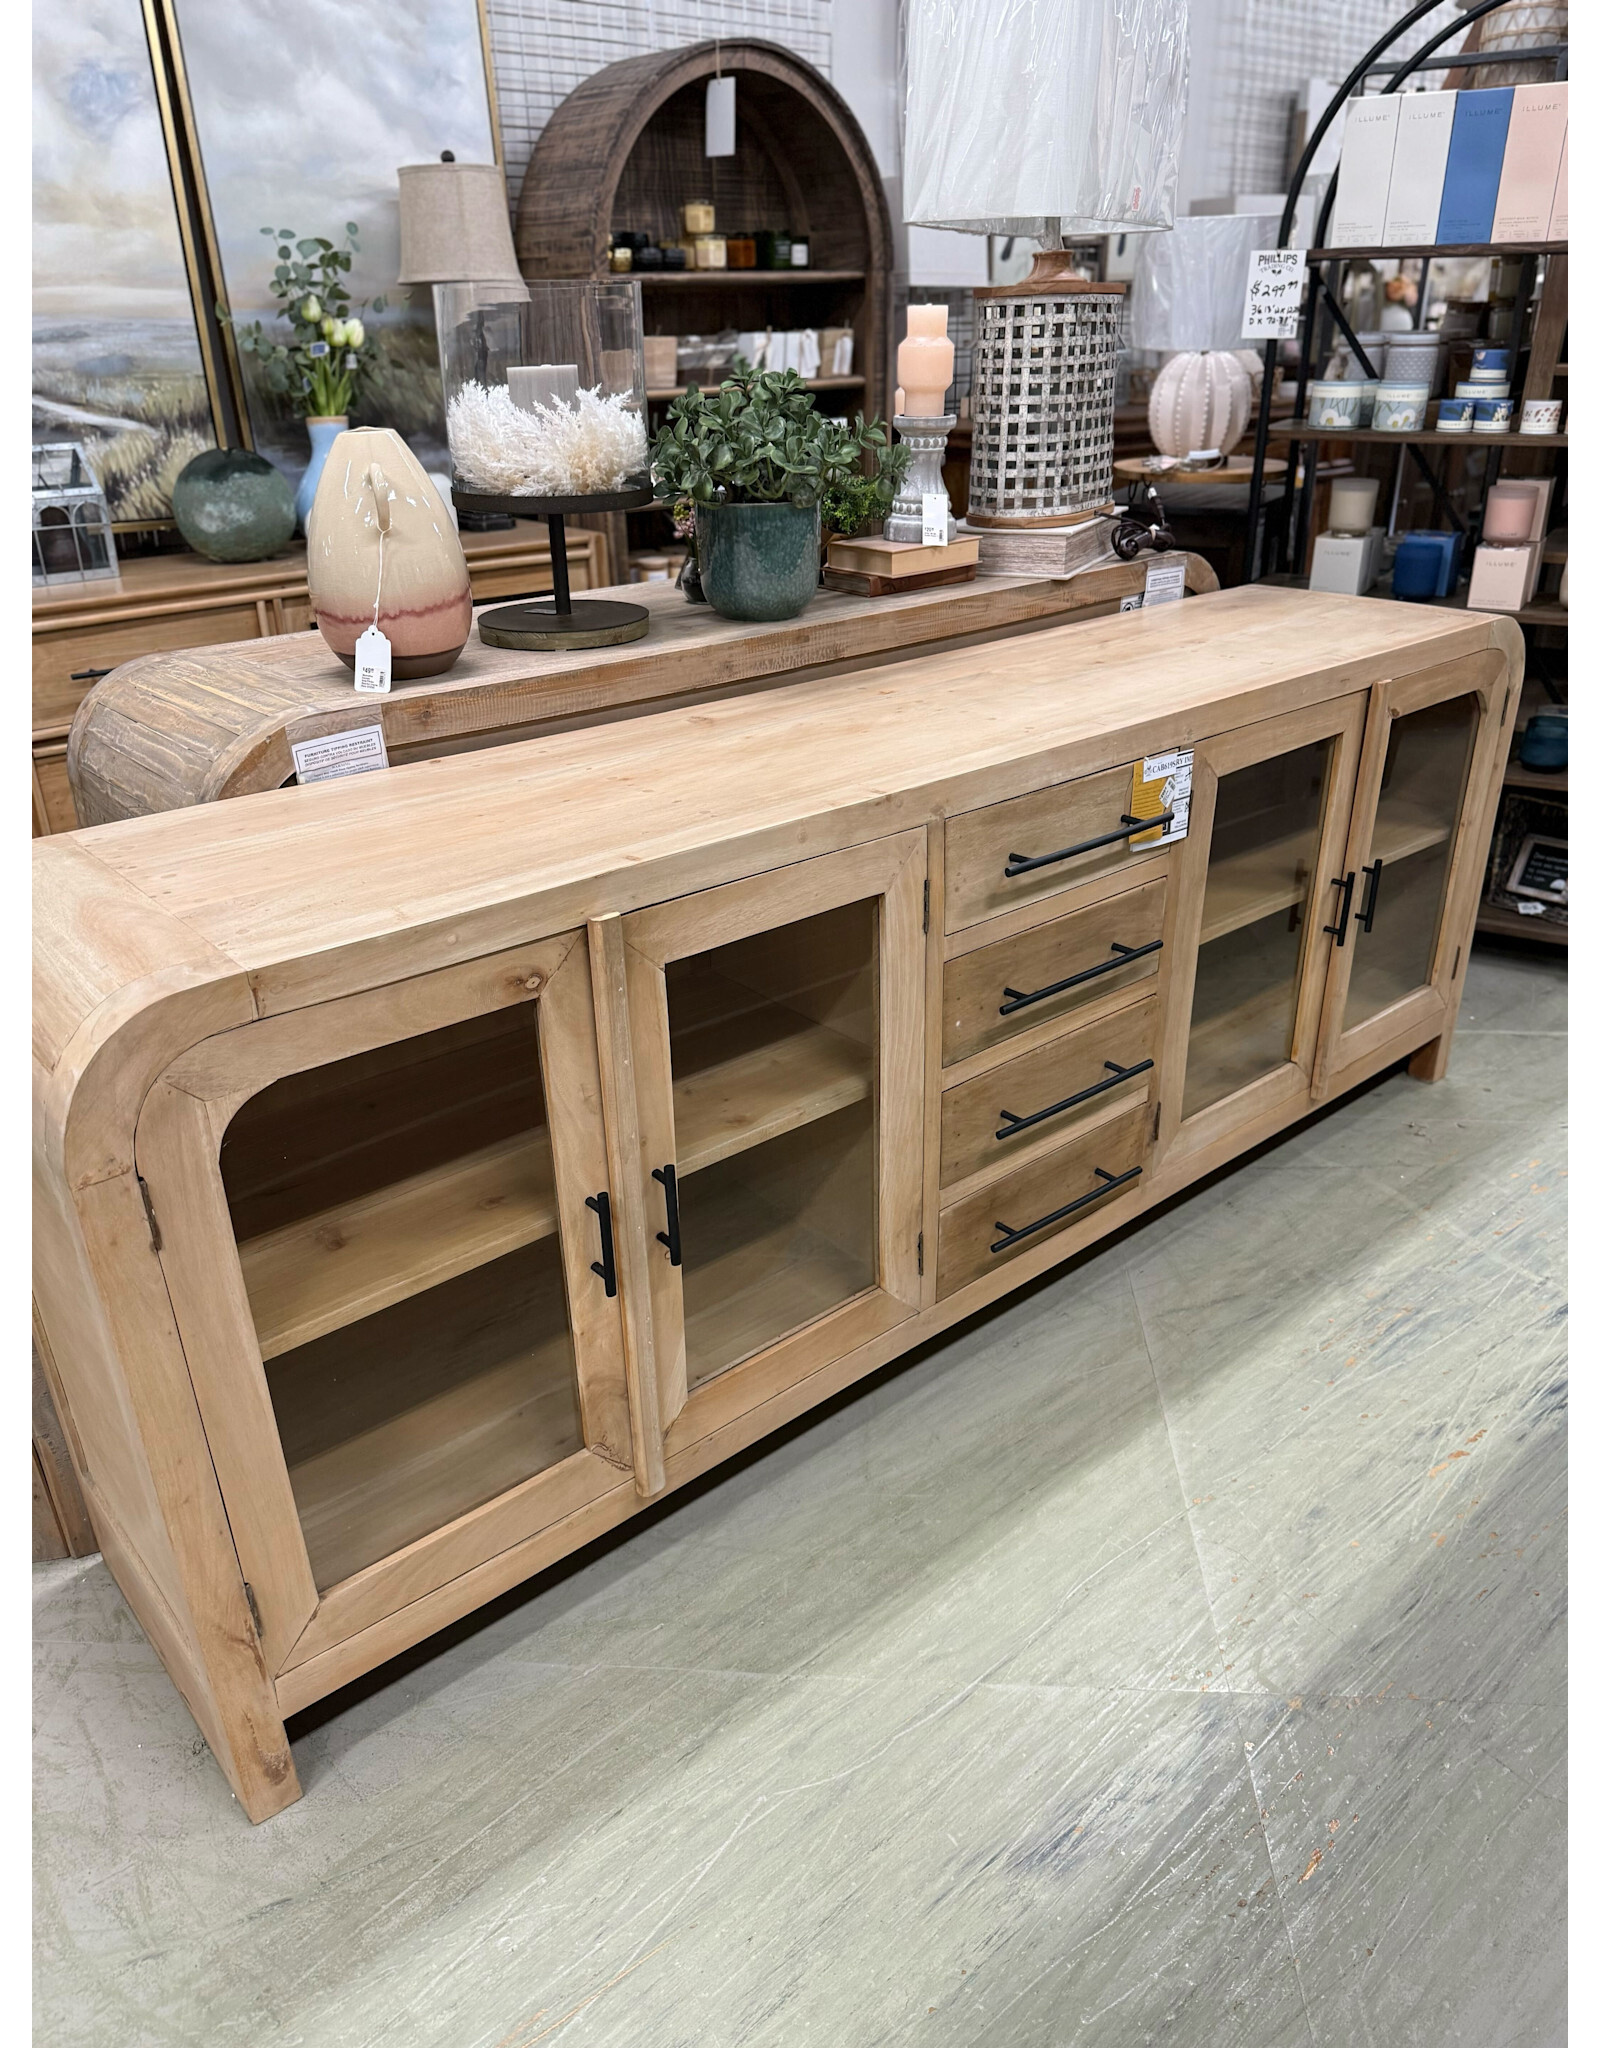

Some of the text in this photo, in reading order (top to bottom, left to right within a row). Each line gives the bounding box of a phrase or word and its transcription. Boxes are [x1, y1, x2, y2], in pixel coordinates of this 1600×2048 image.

[1522, 103, 1559, 112] ILLUME
[1408, 111, 1444, 120] ILLUME
[1465, 108, 1503, 117] ILLUME
[1354, 114, 1390, 123] ILLUME
[1258, 254, 1298, 266] PHILLIPS
[1260, 263, 1285, 273] TRADING
